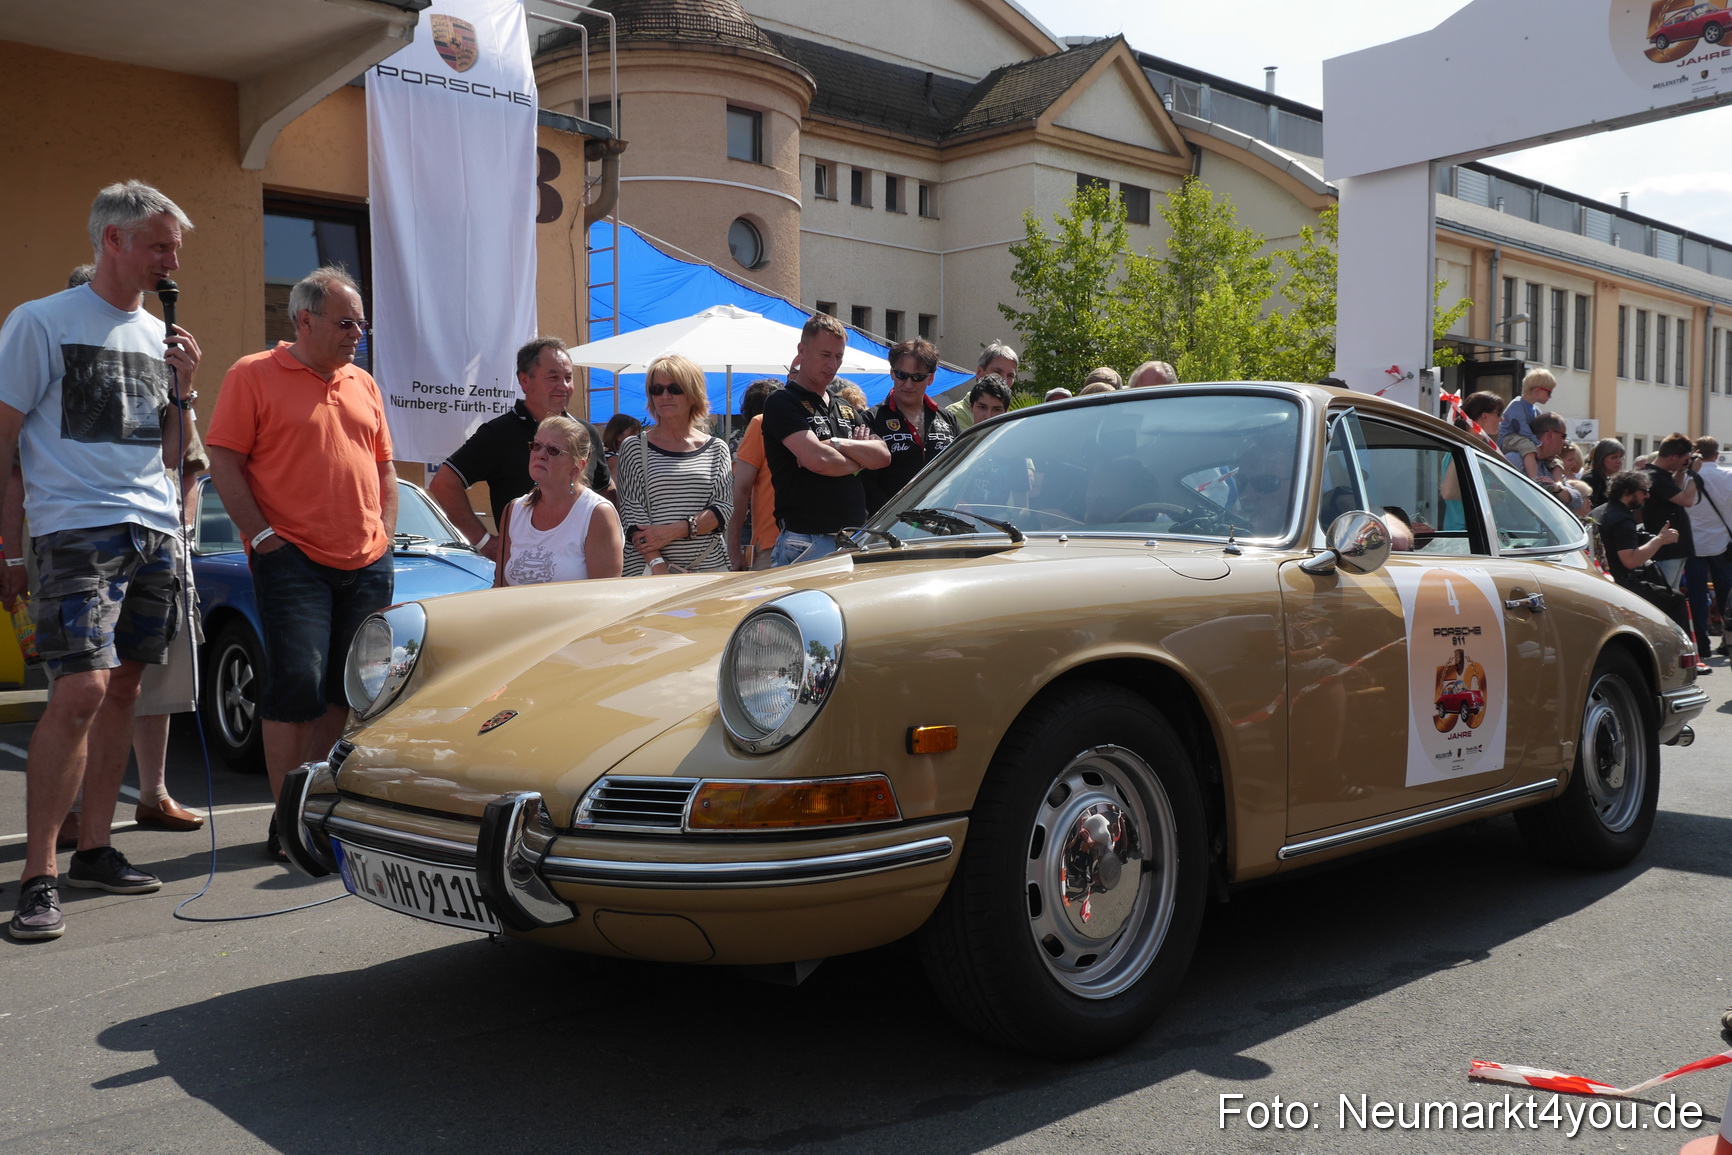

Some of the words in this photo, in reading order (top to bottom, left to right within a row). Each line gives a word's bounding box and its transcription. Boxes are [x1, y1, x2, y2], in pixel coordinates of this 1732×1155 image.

[1677, 49, 1731, 67] JAHRE
[377, 65, 532, 107] PORSCHE
[412, 380, 465, 396] Porsche
[469, 384, 516, 399] Zentrum
[390, 394, 514, 414] Nürnberg-Fürth-Erla
[1445, 578, 1460, 615] 4
[1433, 626, 1482, 637] PORSCHE
[1452, 636, 1466, 646] 911
[1448, 730, 1473, 741] JAHRE
